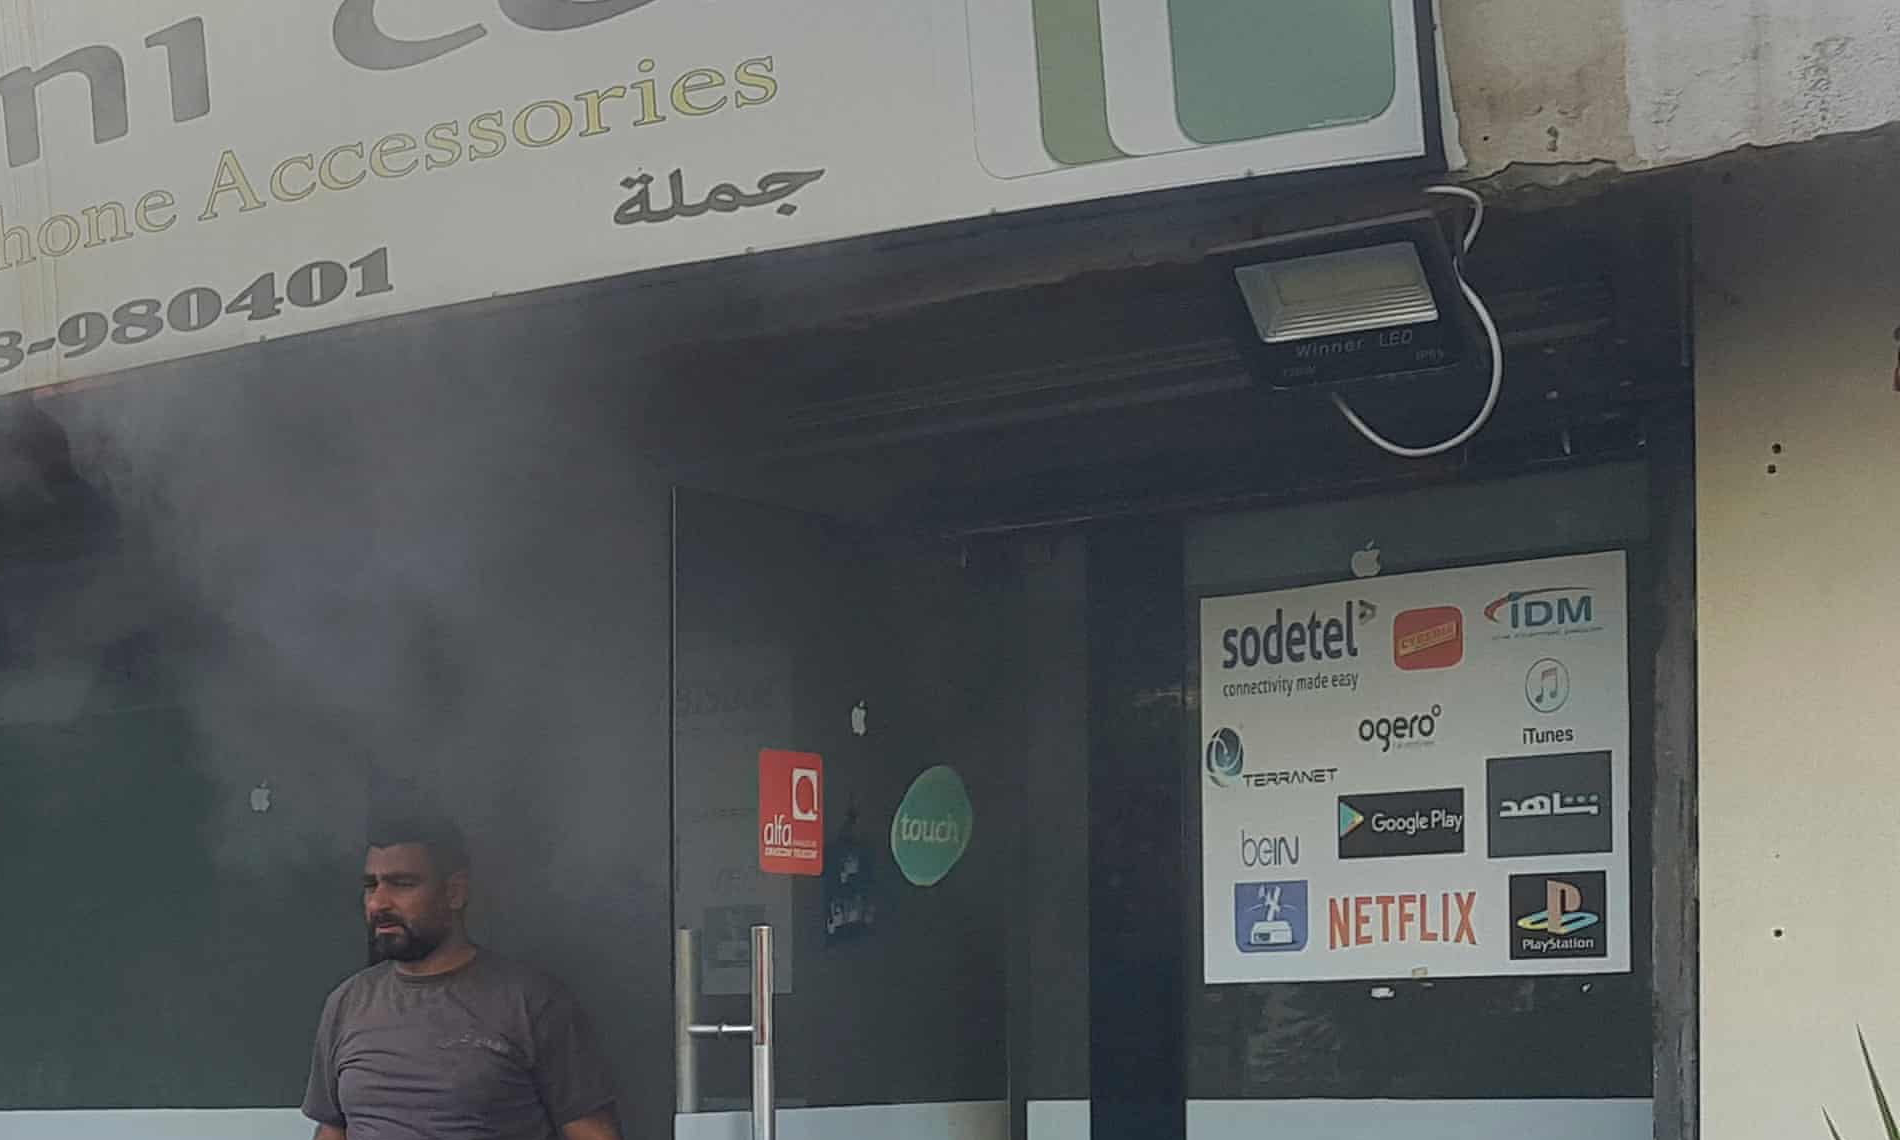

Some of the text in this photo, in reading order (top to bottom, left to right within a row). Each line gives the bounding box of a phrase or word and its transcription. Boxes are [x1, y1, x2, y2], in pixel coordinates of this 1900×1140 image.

[199, 56, 780, 222] Accessories
[613, 166, 827, 226] جملة
[1222, 600, 1359, 670] sodetel
[1222, 672, 1359, 698] connectivity made easy
[1522, 727, 1574, 745] iTunes
[1242, 767, 1339, 788] TERRANET
[1500, 791, 1599, 817] شاهد
[763, 813, 794, 847] alfa
[899, 812, 959, 844] touch
[1371, 808, 1463, 836] Google Play
[1328, 891, 1478, 951] NETFLIX
[1521, 937, 1595, 954] PlayStation
